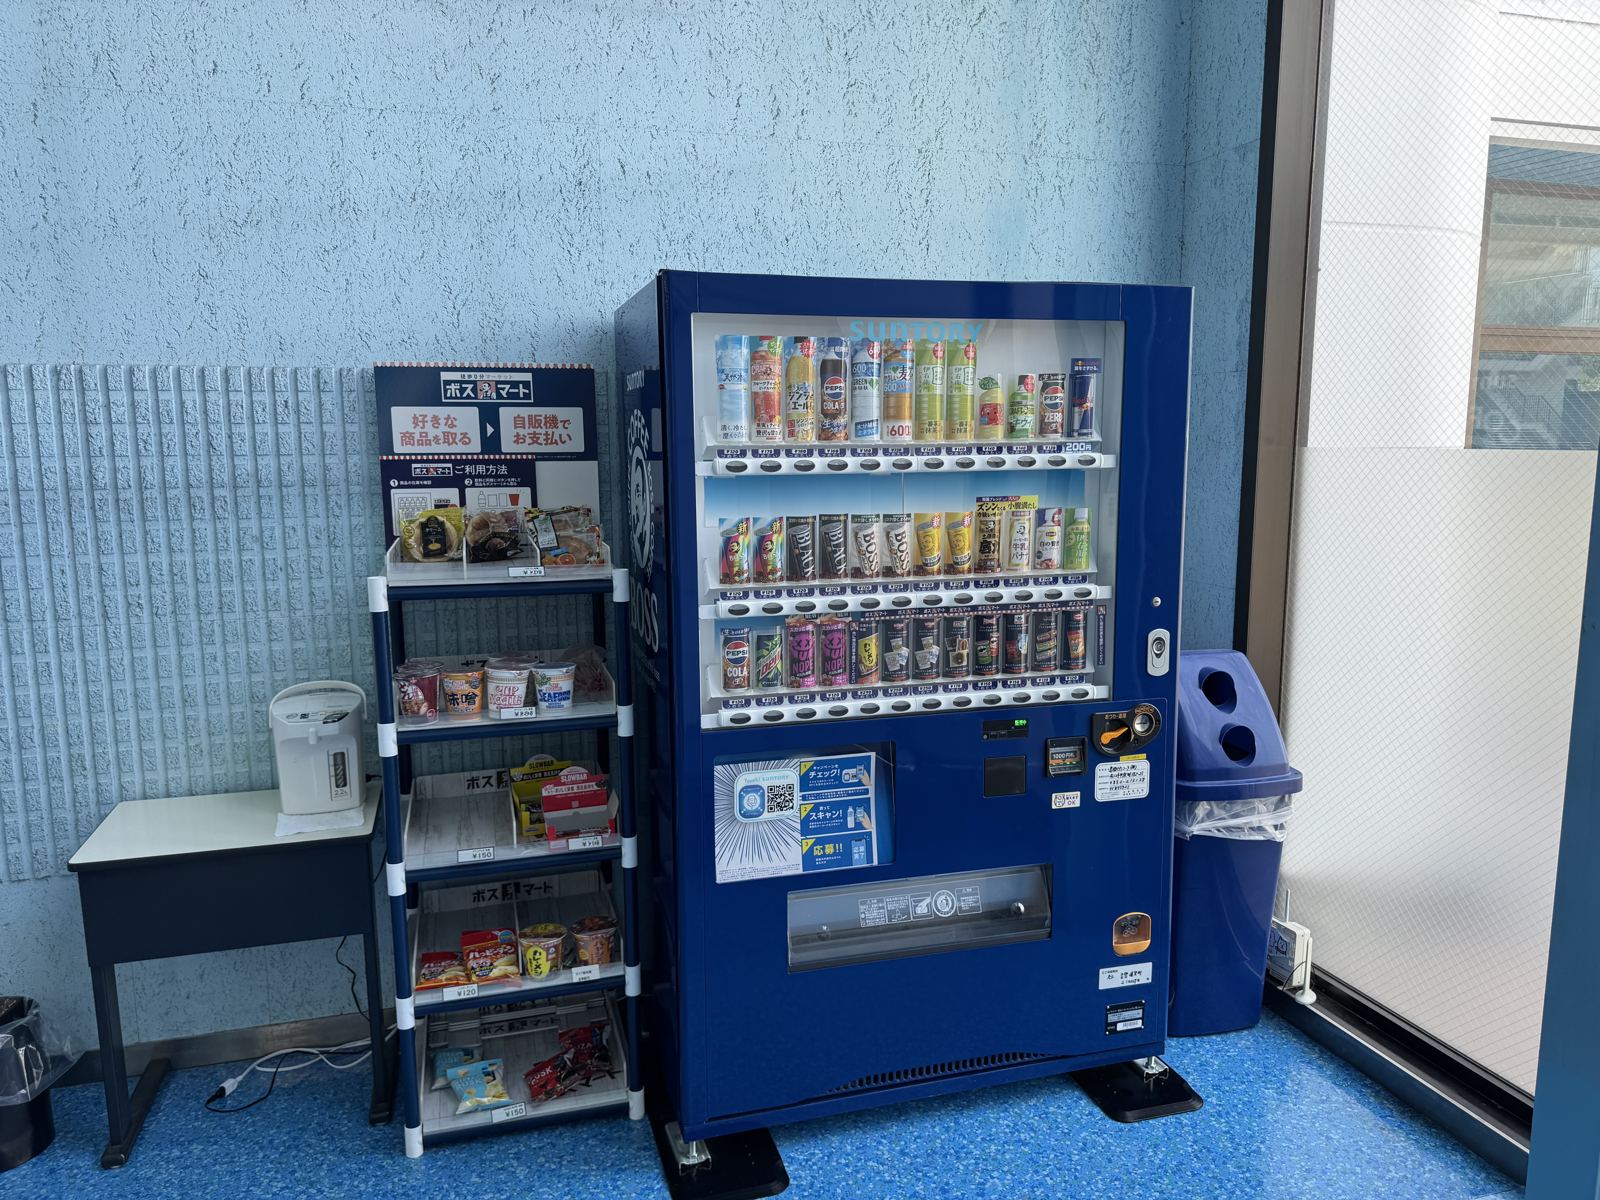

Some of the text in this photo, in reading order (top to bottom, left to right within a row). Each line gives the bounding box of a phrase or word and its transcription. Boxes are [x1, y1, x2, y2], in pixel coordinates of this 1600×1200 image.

[849, 319, 984, 342] SUNTORY
[446, 382, 530, 398] ボス マート
[412, 413, 457, 428] 好きな
[512, 414, 571, 429] 自販機で
[400, 430, 472, 447] 商品を取る
[512, 431, 572, 446] お支払い
[627, 408, 650, 460] COFFEE
[1066, 442, 1092, 451] 200円
[455, 464, 508, 475] ご利用方法
[796, 525, 816, 578] BLACK
[828, 521, 848, 575] BLACK
[862, 529, 879, 572] BOSS
[894, 529, 911, 571] BOSS
[630, 576, 659, 653] BOSS
[725, 649, 748, 657] PEPSI
[726, 667, 748, 678] COLA
[447, 691, 478, 706] 味噌
[537, 689, 571, 702] SEAFOOD
[561, 773, 588, 783] SLOWBAR
[809, 768, 840, 779] チェック!
[466, 775, 494, 790] ボス
[809, 809, 843, 821] スキャン!
[472, 881, 553, 903] ボス マート
[457, 988, 476, 997] ¥120
[504, 1107, 524, 1118] ¥150
